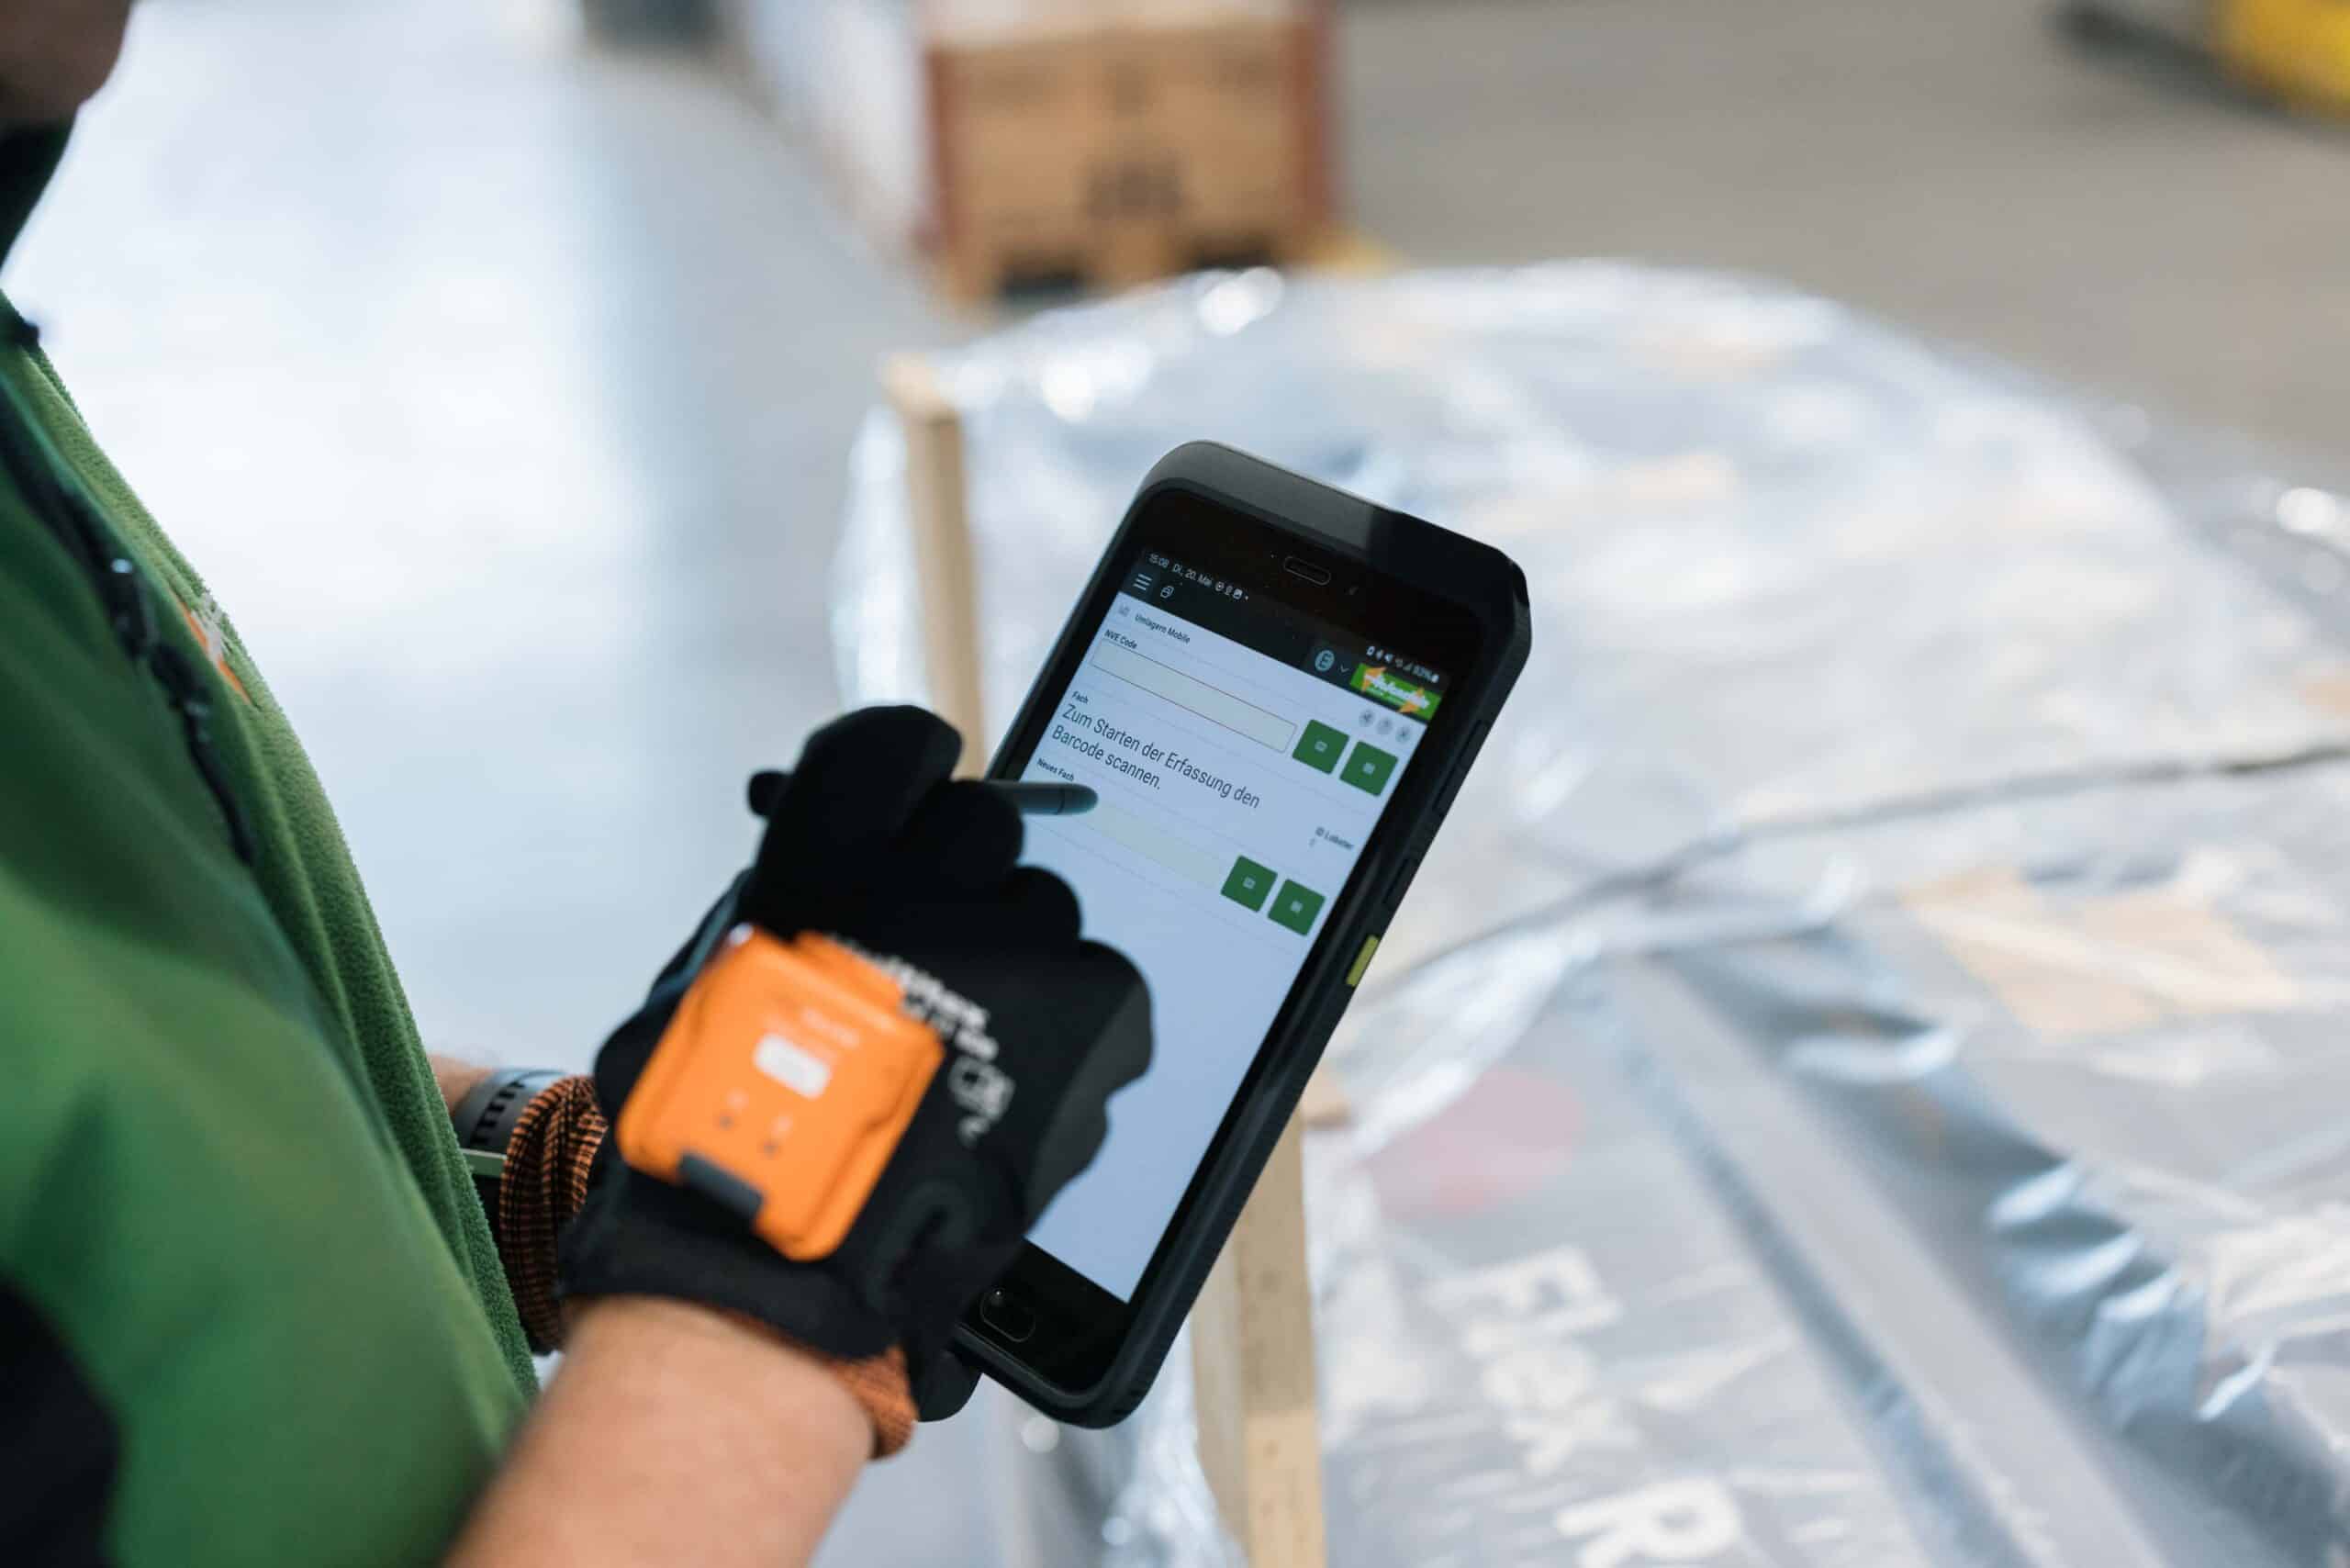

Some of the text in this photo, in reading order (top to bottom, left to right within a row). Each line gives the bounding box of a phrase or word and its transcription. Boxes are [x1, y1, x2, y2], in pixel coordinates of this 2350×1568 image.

[1104, 629, 1137, 649] NVE Code
[1135, 613, 1191, 644] Umlagern Mobile
[1072, 690, 1089, 704] Fach
[1036, 757, 1075, 782] Neues Fach
[1052, 724, 1160, 790] Barcode scannen.
[1062, 703, 1260, 809] Zum Starten der Erfassung den
